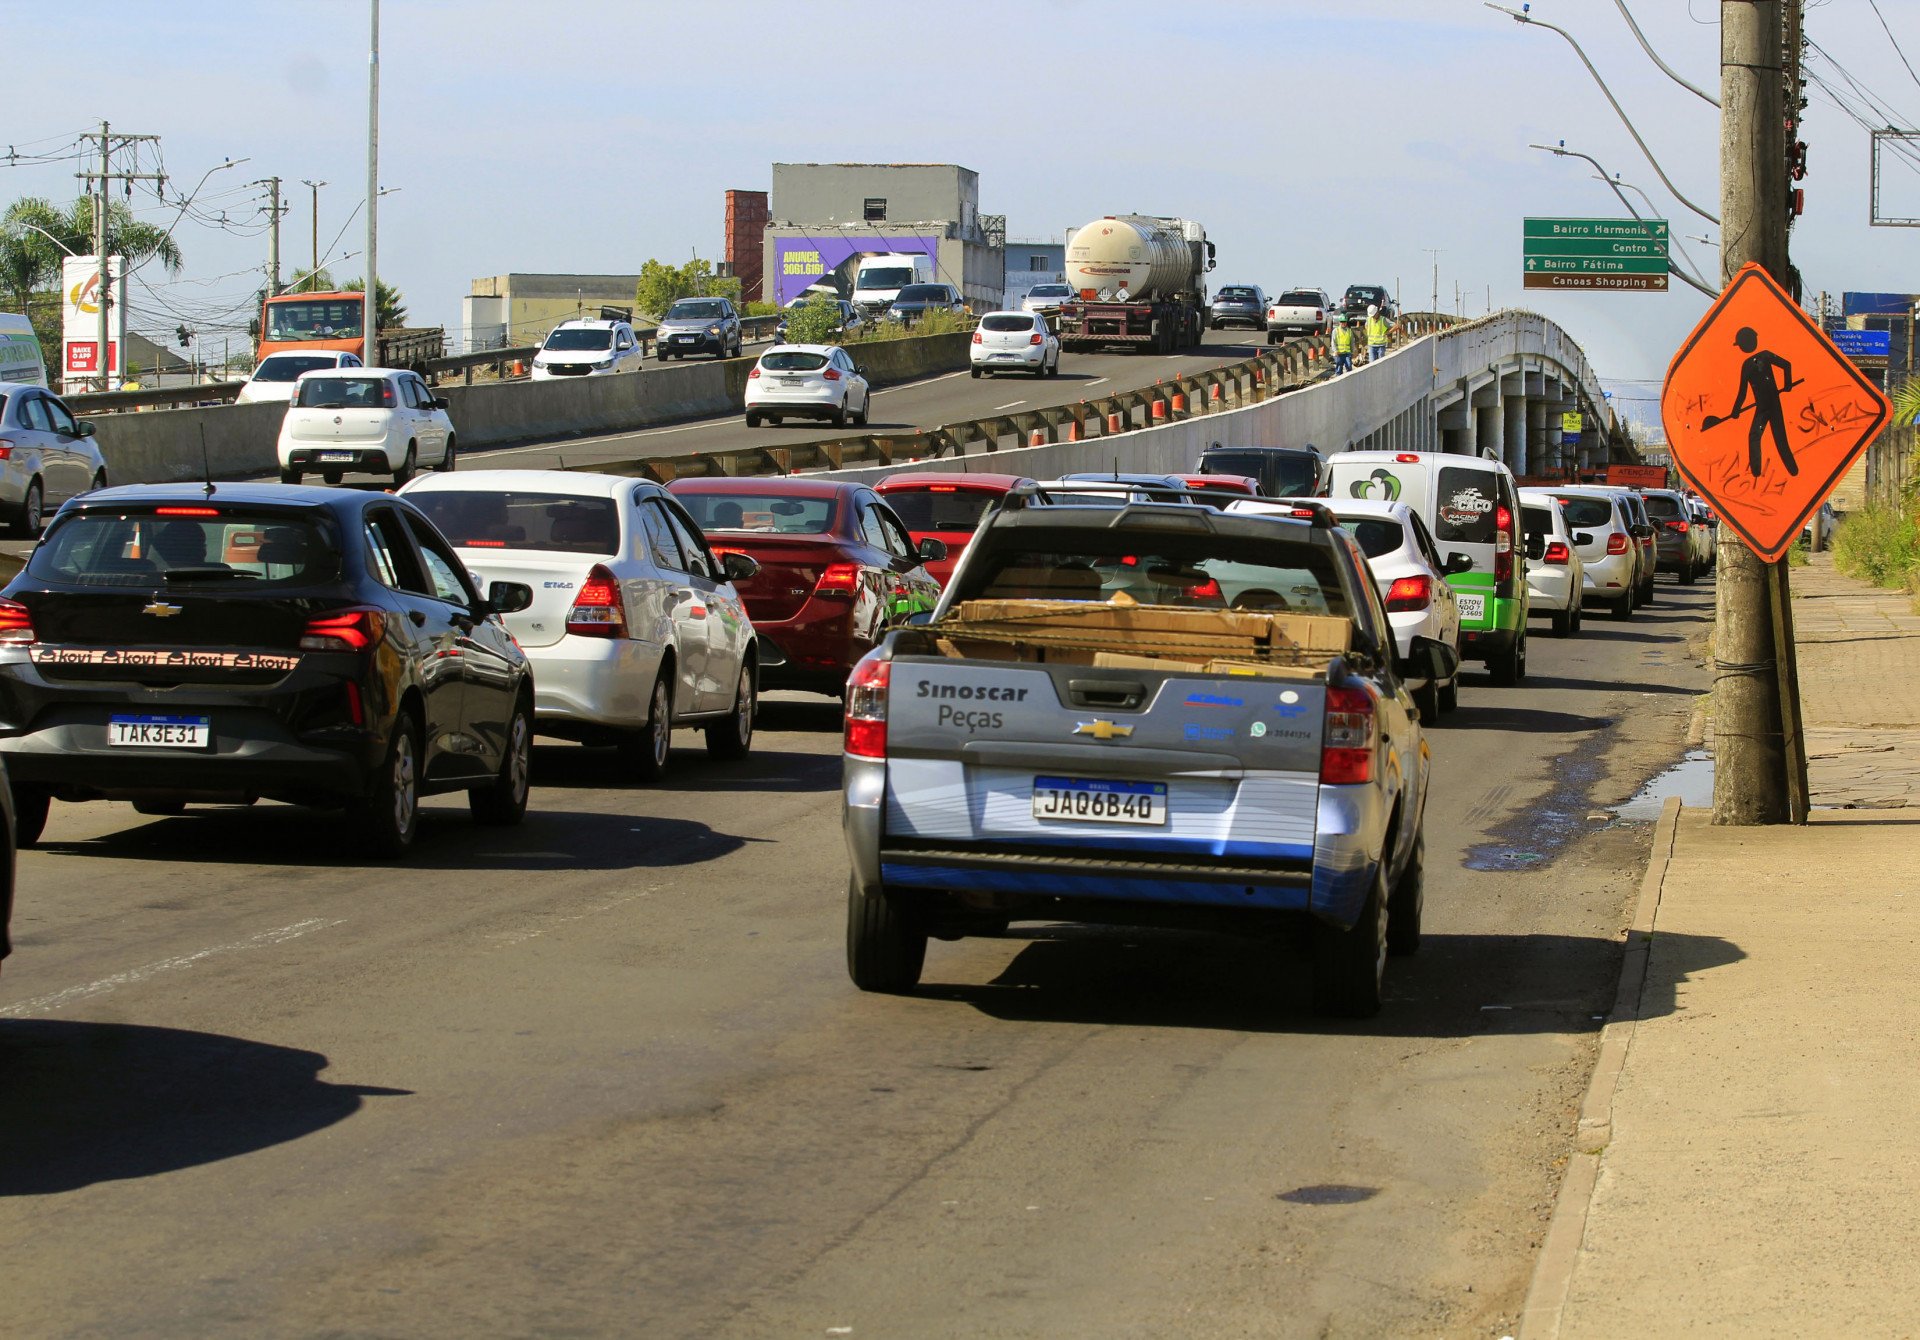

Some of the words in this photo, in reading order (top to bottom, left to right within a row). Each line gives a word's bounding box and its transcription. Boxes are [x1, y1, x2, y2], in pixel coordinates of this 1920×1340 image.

[1553, 224, 1589, 234] Bairro
[1594, 225, 1647, 235] Harmonia
[1612, 243, 1647, 252] Centro
[783, 251, 820, 263] ANUNCIE
[783, 263, 824, 275] 3061.6161
[1544, 260, 1576, 269] Bairro
[1583, 259, 1624, 270] Fátima
[1552, 276, 1592, 286] Canoas
[1595, 276, 1647, 289] Shopping
[72, 346, 92, 354] BAIXE
[1618, 467, 1655, 477] ATENÇÃO
[1457, 500, 1493, 513] CACO
[61, 650, 93, 663] kovi
[124, 651, 157, 665] kovi
[190, 652, 224, 666] kovi
[256, 654, 292, 670] kovi
[917, 679, 1028, 702] Sinoscar
[938, 704, 1003, 734] Peças
[118, 723, 198, 744] TAK3E31
[1044, 790, 1152, 819] JAQ6B40
